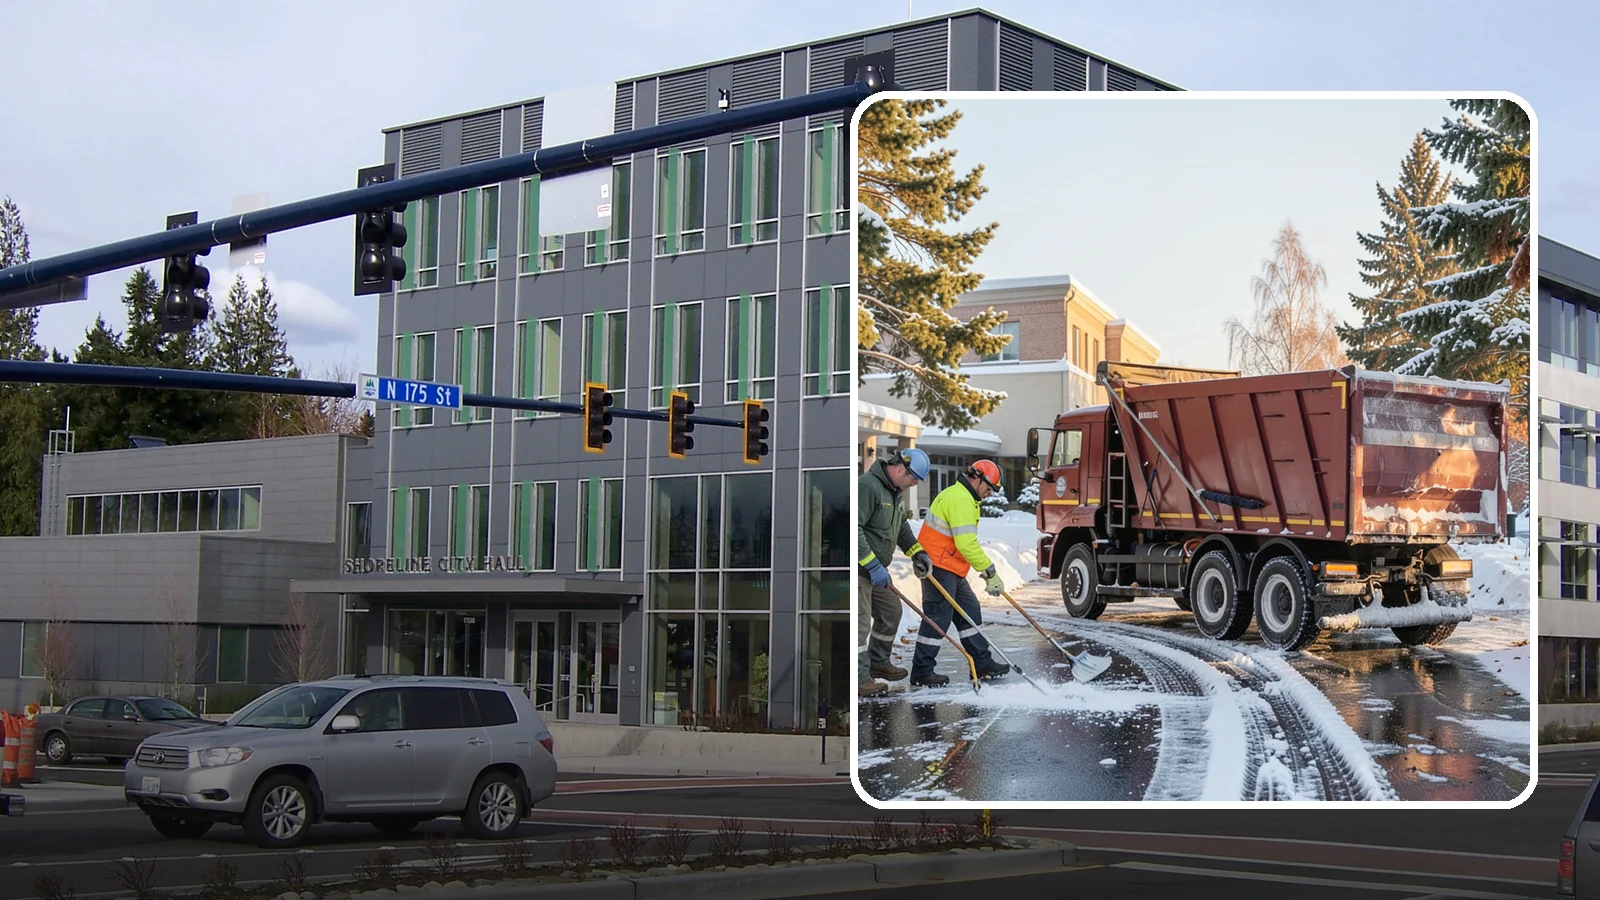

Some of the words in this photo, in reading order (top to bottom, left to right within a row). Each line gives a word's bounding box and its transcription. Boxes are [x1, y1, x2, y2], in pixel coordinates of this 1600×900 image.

[387, 380, 396, 399] N
[405, 382, 427, 402] 175
[436, 386, 451, 406] St
[344, 558, 432, 574] SHORELINE
[438, 556, 475, 572] CITY
[484, 555, 526, 571] HALL
